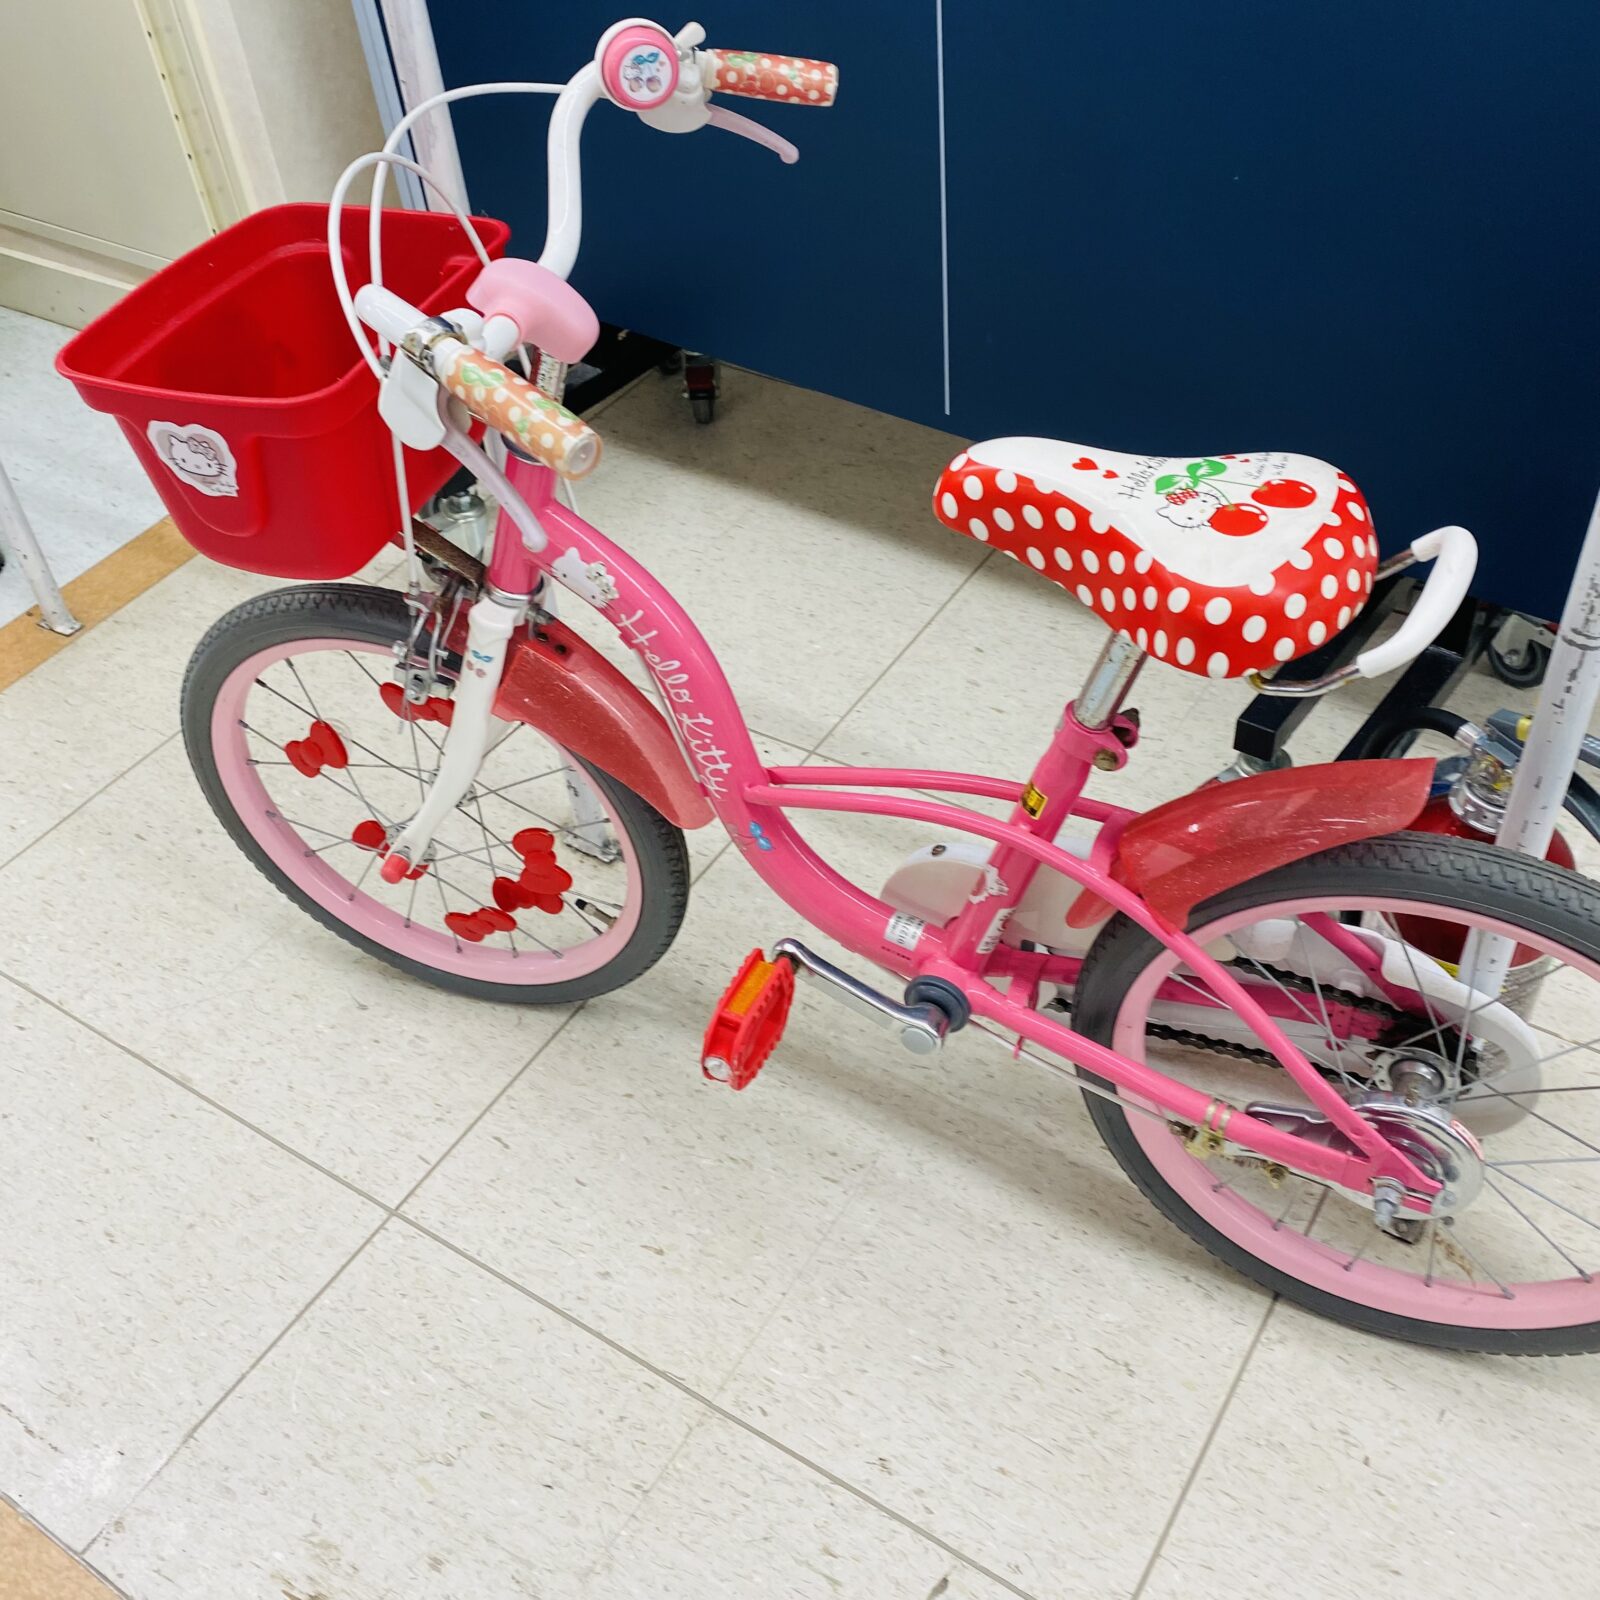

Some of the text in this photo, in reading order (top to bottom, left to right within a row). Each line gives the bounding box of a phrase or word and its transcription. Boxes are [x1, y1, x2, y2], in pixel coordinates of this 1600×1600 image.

[1117, 470, 1155, 500] Hello
[617, 609, 732, 800] Hello Kitty
